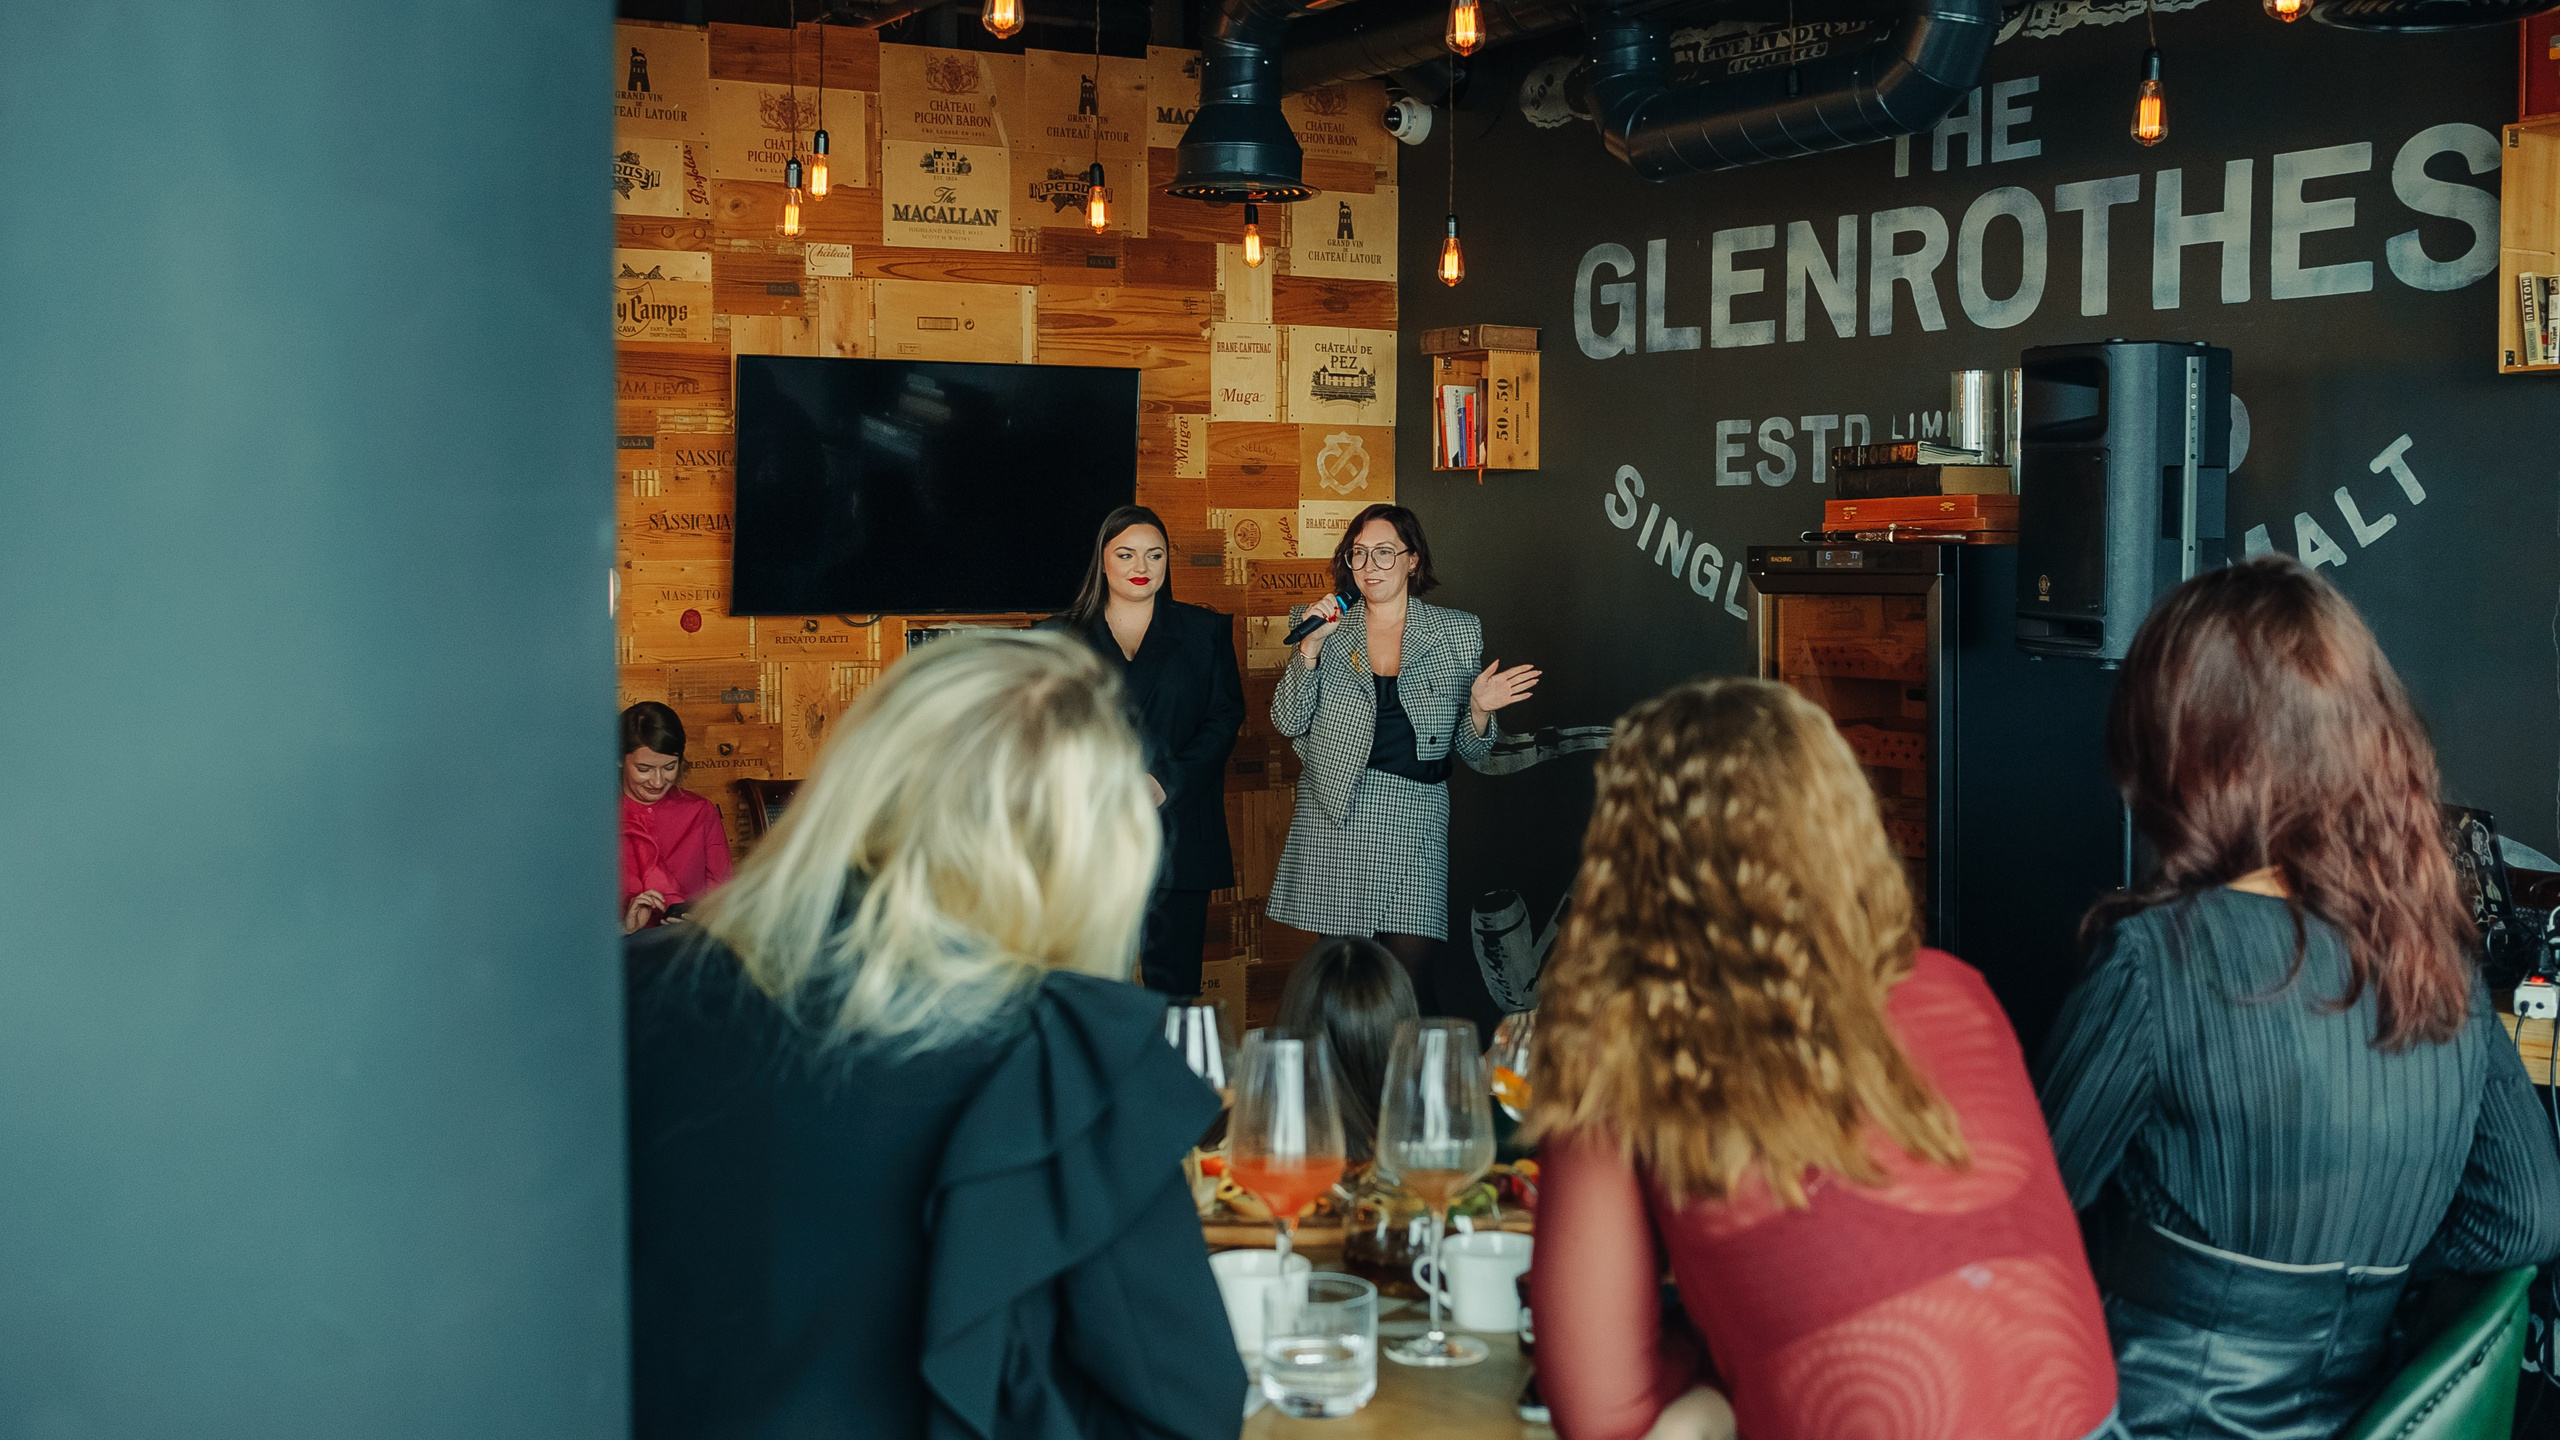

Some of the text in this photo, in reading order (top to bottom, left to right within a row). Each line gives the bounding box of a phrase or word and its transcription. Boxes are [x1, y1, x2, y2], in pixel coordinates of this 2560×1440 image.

[615, 90, 663, 102] GRAND VIN
[645, 108, 688, 122] LATOUR
[914, 112, 991, 128] PICHON BARON
[1067, 113, 1094, 124] GRAND
[1093, 129, 1130, 143] LATOUR
[1327, 135, 1358, 147] BARON
[747, 150, 789, 164] PICHON
[931, 186, 957, 205] The
[892, 203, 1001, 227] MACALLAN
[1327, 238, 1364, 248] GRAND VIN
[1573, 122, 2501, 361] GLENROTHES
[1308, 251, 1382, 265] CHATEAU LATOUR
[2522, 278, 2534, 321] ПЛАТОН
[630, 294, 688, 327] Camps
[617, 325, 637, 333] CAVA
[1314, 341, 1373, 355] CHÂTEAU DE
[1330, 355, 1358, 369] PEZ
[1220, 388, 1264, 405] Muga
[1496, 378, 1509, 402] 50
[1496, 417, 1509, 441] 50
[1176, 415, 1191, 469] Muga
[648, 513, 732, 531] SASSICAIA
[1261, 572, 1326, 589] SASSICAIA
[660, 589, 721, 601] MASSETO
[775, 634, 849, 645] RENATO RATTI
[724, 692, 751, 701] GAJA
[688, 757, 764, 770] RENATO RATTI
